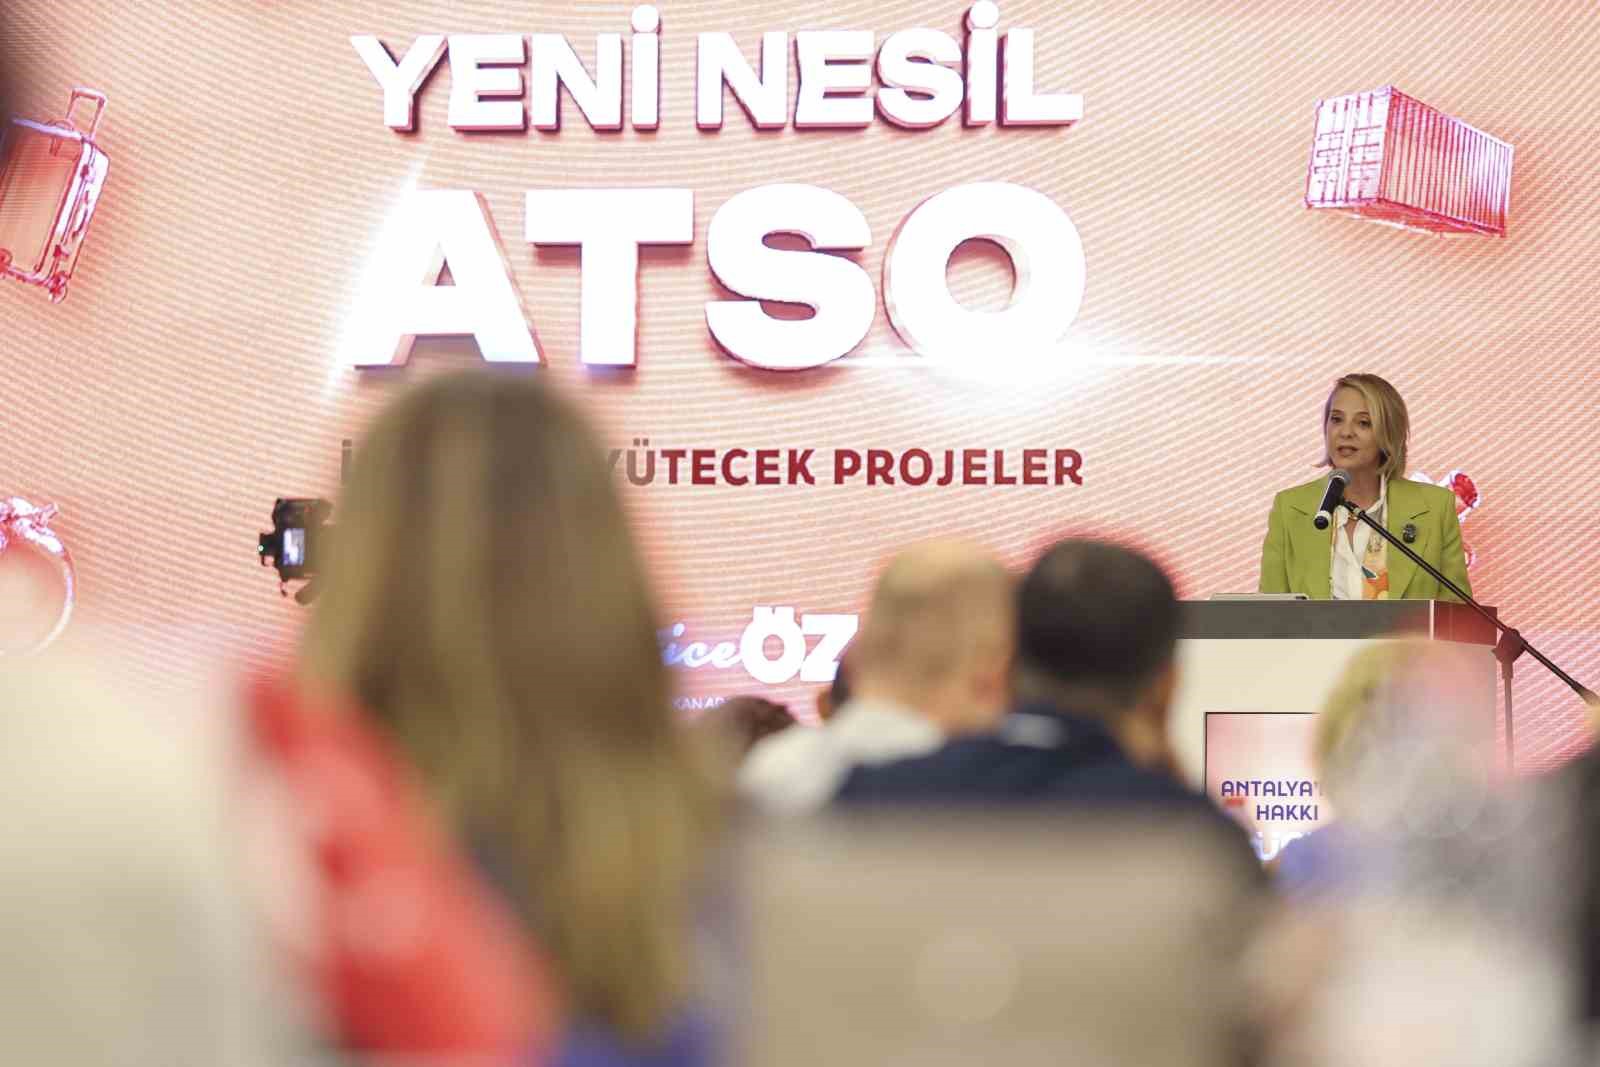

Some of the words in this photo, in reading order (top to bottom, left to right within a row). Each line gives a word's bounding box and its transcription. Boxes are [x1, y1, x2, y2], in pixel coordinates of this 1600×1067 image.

[350, 3, 662, 131] YENİ
[696, 0, 1084, 129] NESİL
[352, 181, 1088, 373] ATSO
[833, 448, 1083, 486] PROJELER
[661, 623, 742, 668] ice
[1220, 780, 1324, 797] ANTALYA'
[1256, 804, 1318, 821] HAKKI
